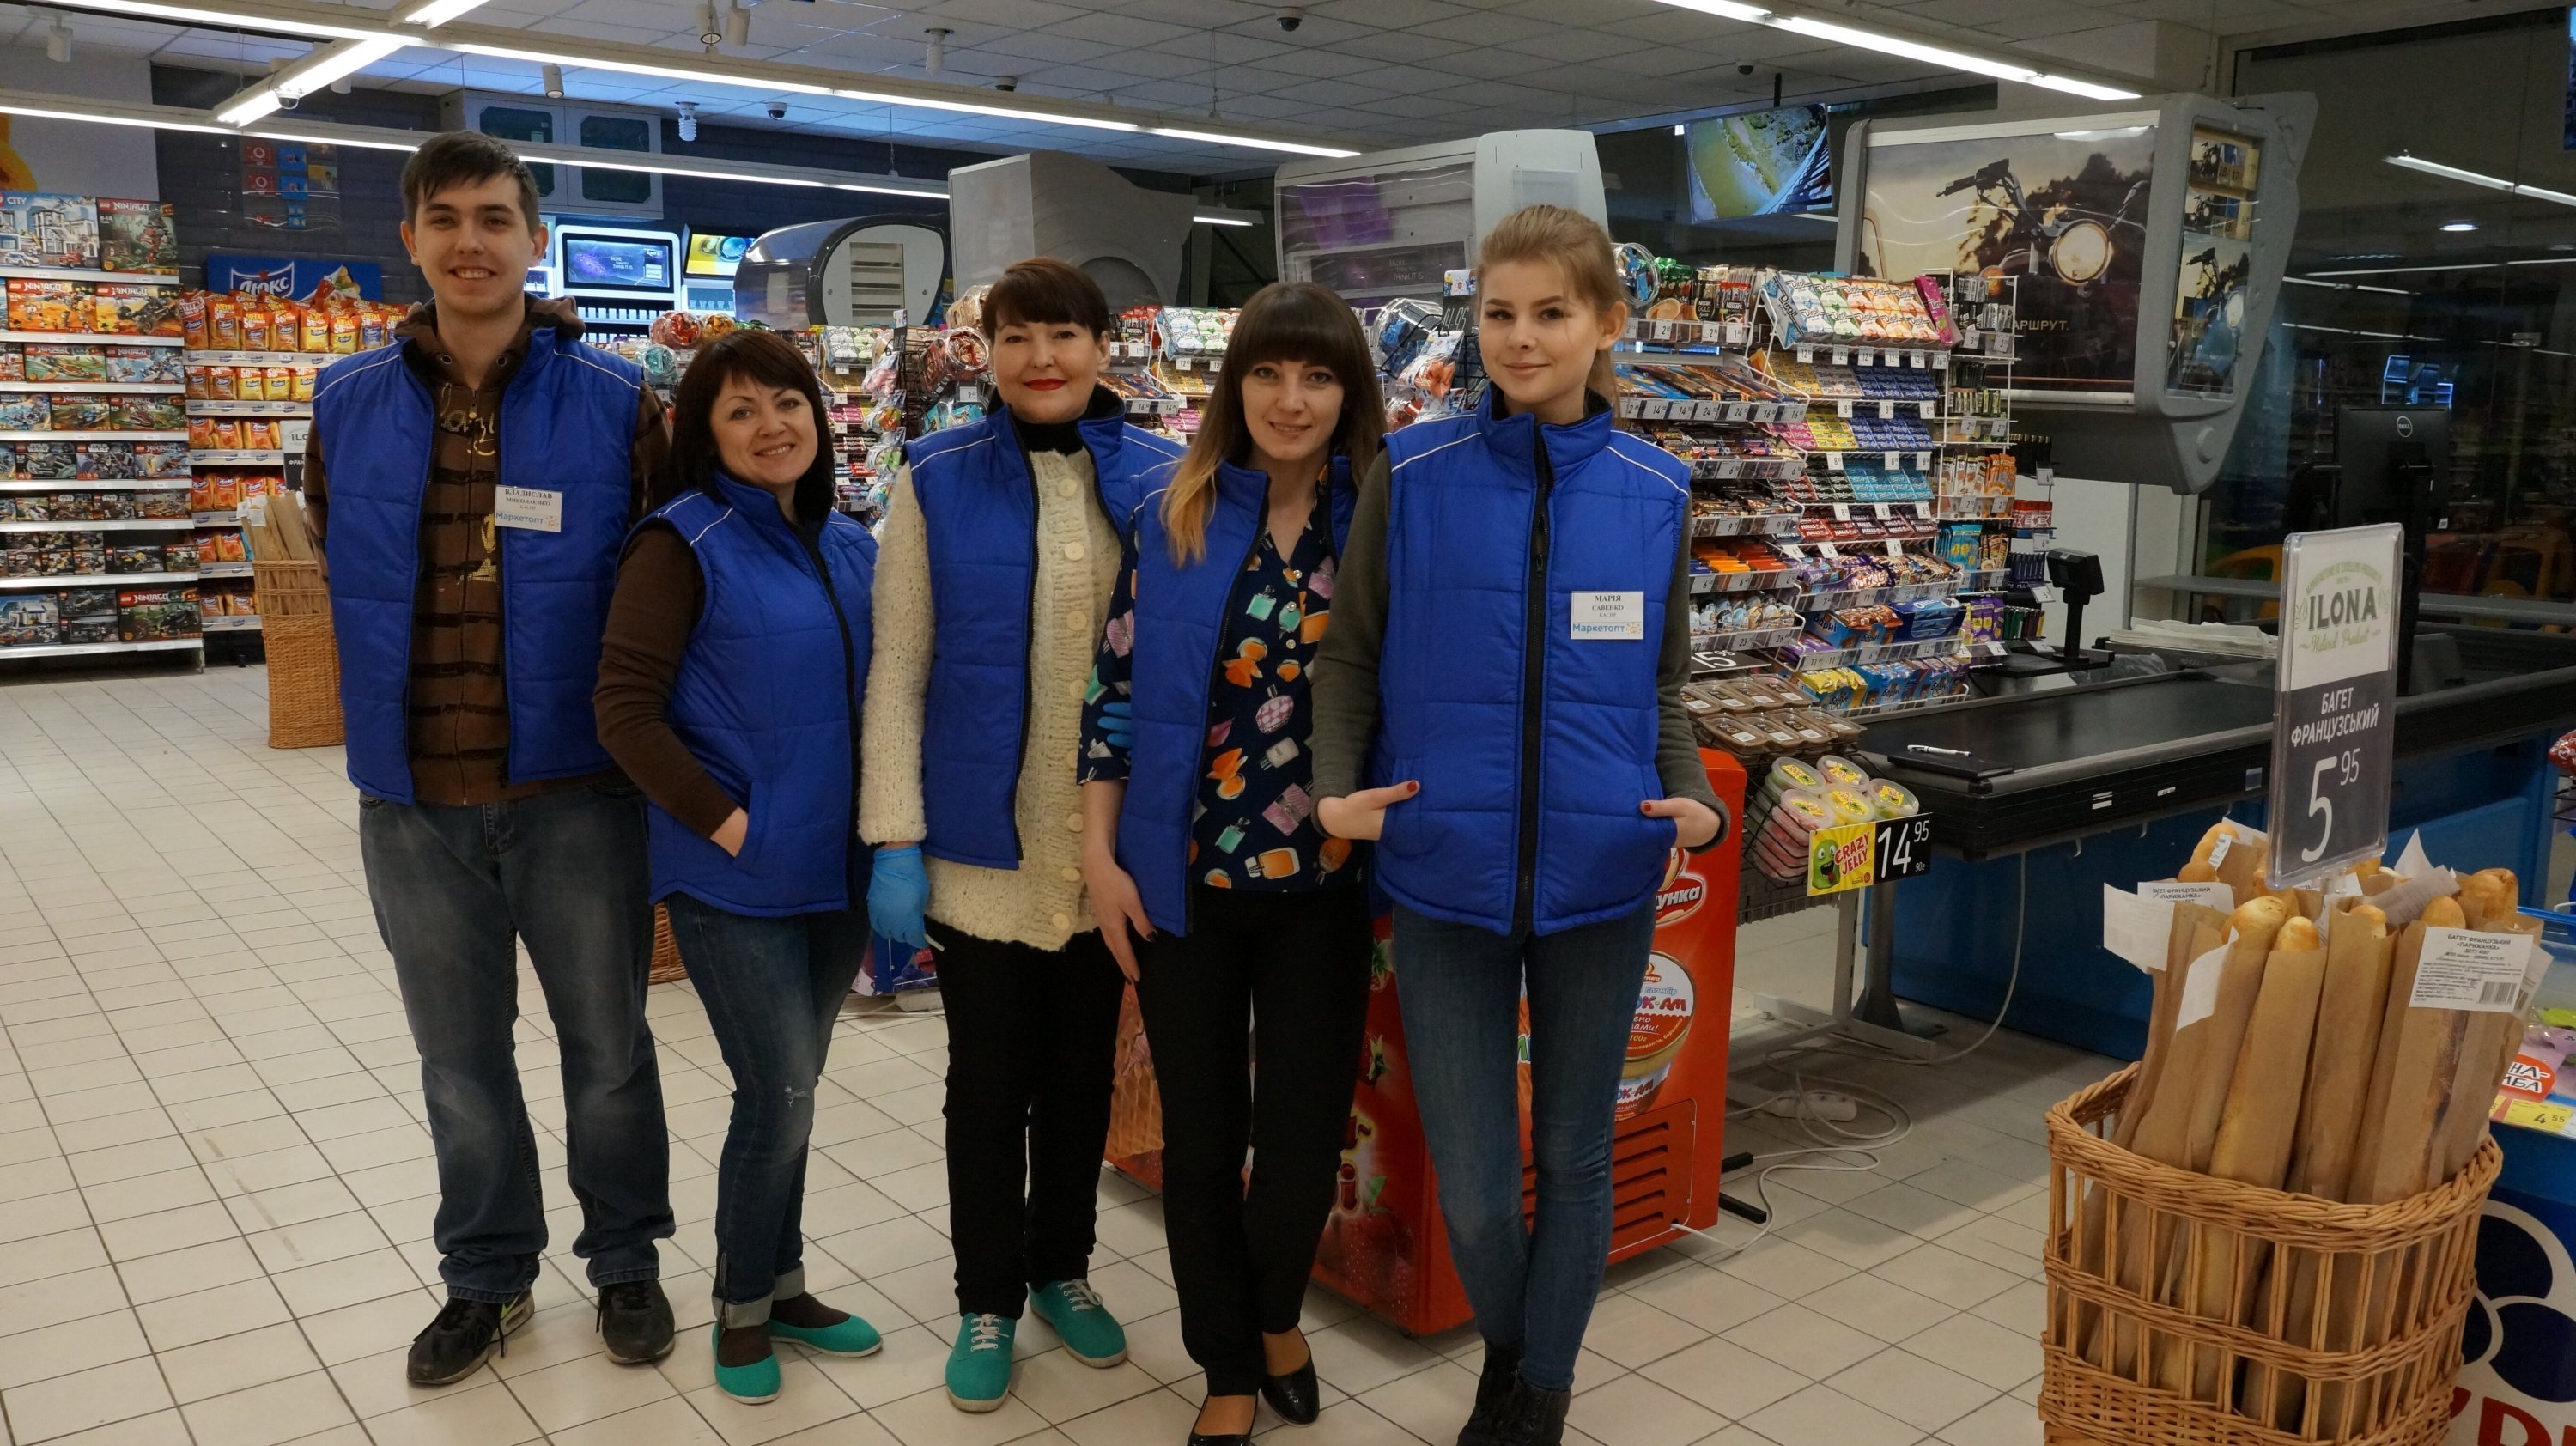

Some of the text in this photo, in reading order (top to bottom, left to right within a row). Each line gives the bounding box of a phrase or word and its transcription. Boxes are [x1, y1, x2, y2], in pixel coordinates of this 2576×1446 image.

[7, 197, 27, 205] CITY
[112, 202, 151, 213] NINJAGO
[23, 282, 63, 292] NINJAGO
[111, 286, 149, 296] NINJAGO
[505, 489, 553, 499] ВЛАДИСЛАВ
[495, 512, 544, 525] Маркетопт
[133, 593, 170, 603] NINJAGO
[2308, 586, 2378, 631] ILONA
[1572, 623, 1625, 634] Маркетопт
[2321, 688, 2354, 714] БАГЕТ
[2291, 702, 2379, 747] ФРАНЦУЗСЬКИЙ
[2301, 748, 2360, 862] 5 95
[1834, 831, 1870, 865] CRAZY
[1877, 820, 1930, 878] 14 95
[1842, 848, 1868, 876] JELLY
[1656, 886, 1701, 910] унка
[2534, 1113, 2565, 1124] 4 55
